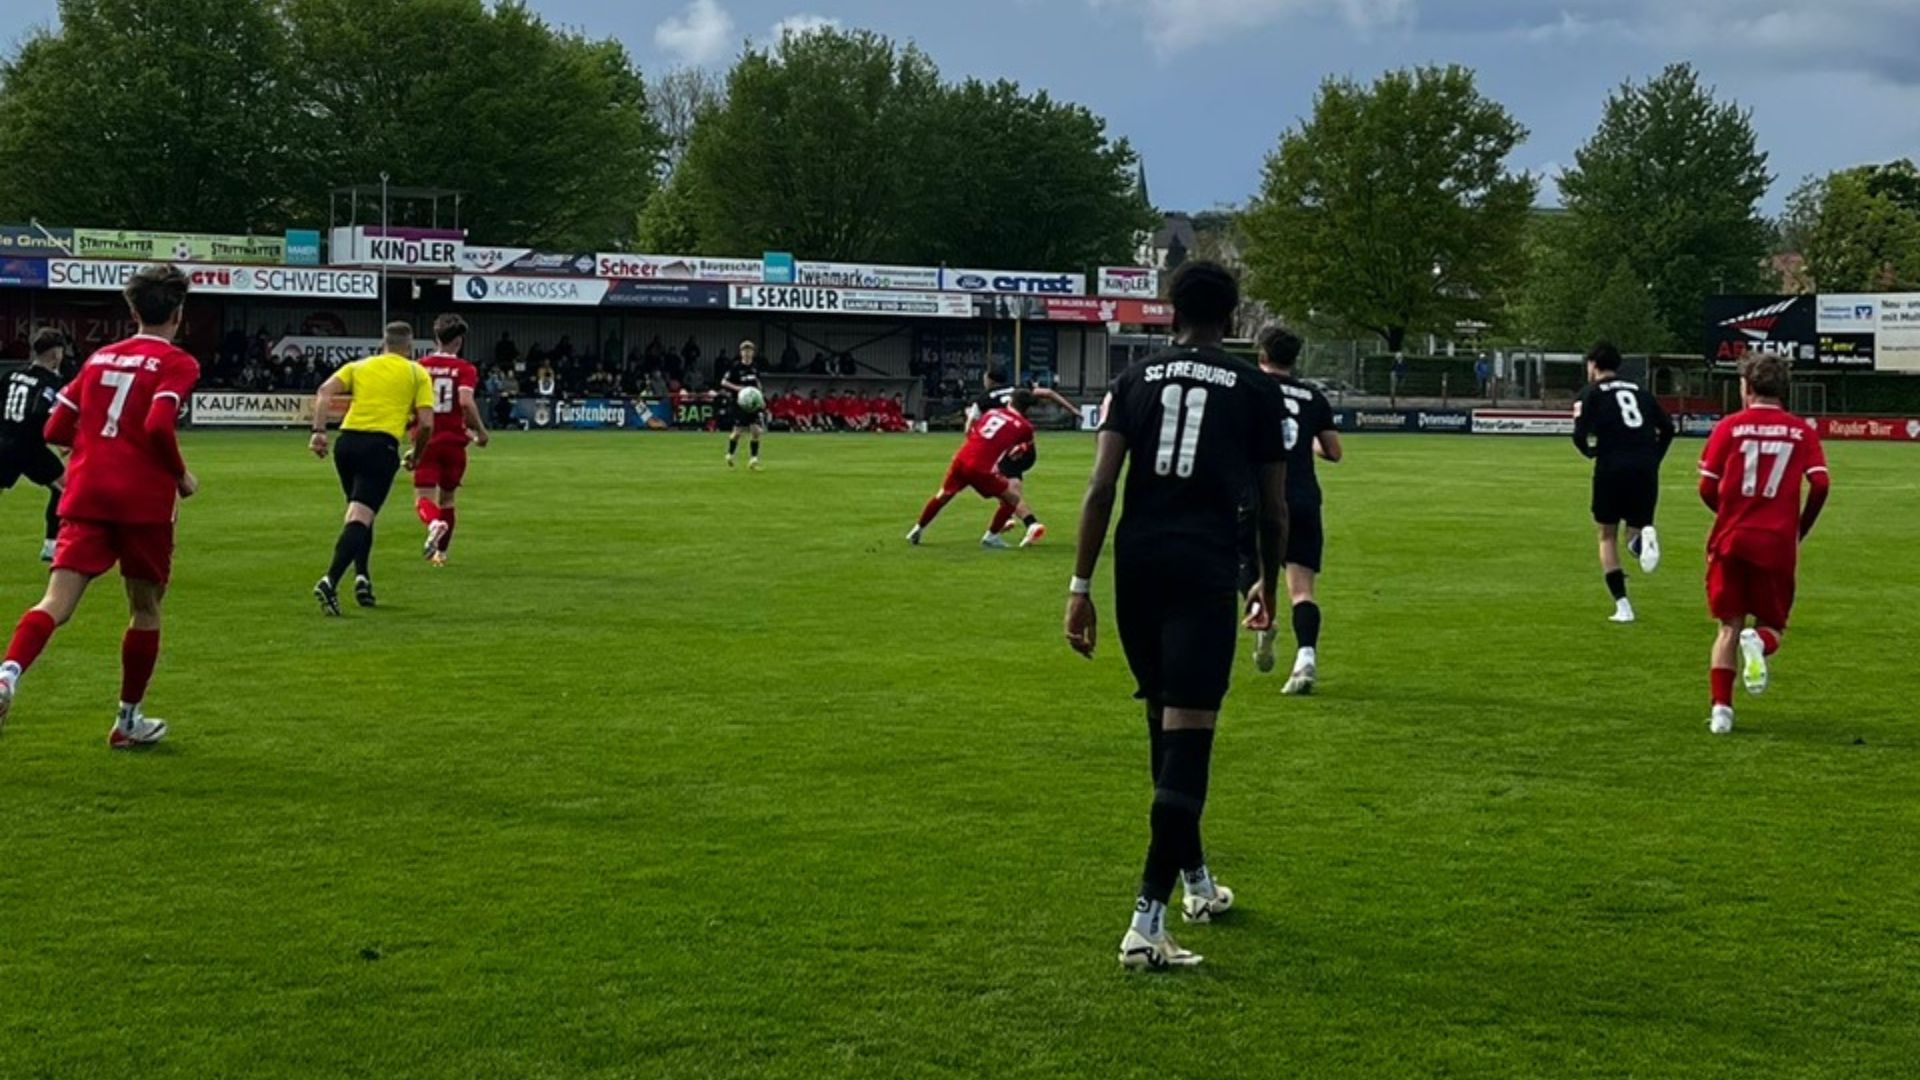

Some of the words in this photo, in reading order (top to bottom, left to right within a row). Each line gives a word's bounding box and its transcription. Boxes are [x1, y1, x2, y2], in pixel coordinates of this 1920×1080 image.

[17, 235, 72, 247] GmbH
[371, 240, 455, 264] KINDLER
[51, 262, 138, 286] SCHWEI
[191, 269, 230, 286] GTÜ
[600, 258, 659, 276] Scheer
[254, 269, 375, 294] SCHWEIGER
[494, 280, 579, 298] KARKOSSA
[992, 275, 1074, 294] ernst
[758, 287, 839, 310] SEXAUER
[1144, 364, 1165, 382] SC
[1165, 360, 1238, 388] FREIBURG
[4, 382, 29, 423] 10
[100, 370, 136, 438] 7
[196, 396, 302, 413] KAUFMANN
[1615, 389, 1644, 429] 8
[555, 402, 625, 430] Fürstenberg
[1155, 383, 1208, 478] 11
[1740, 440, 1794, 498] 17
